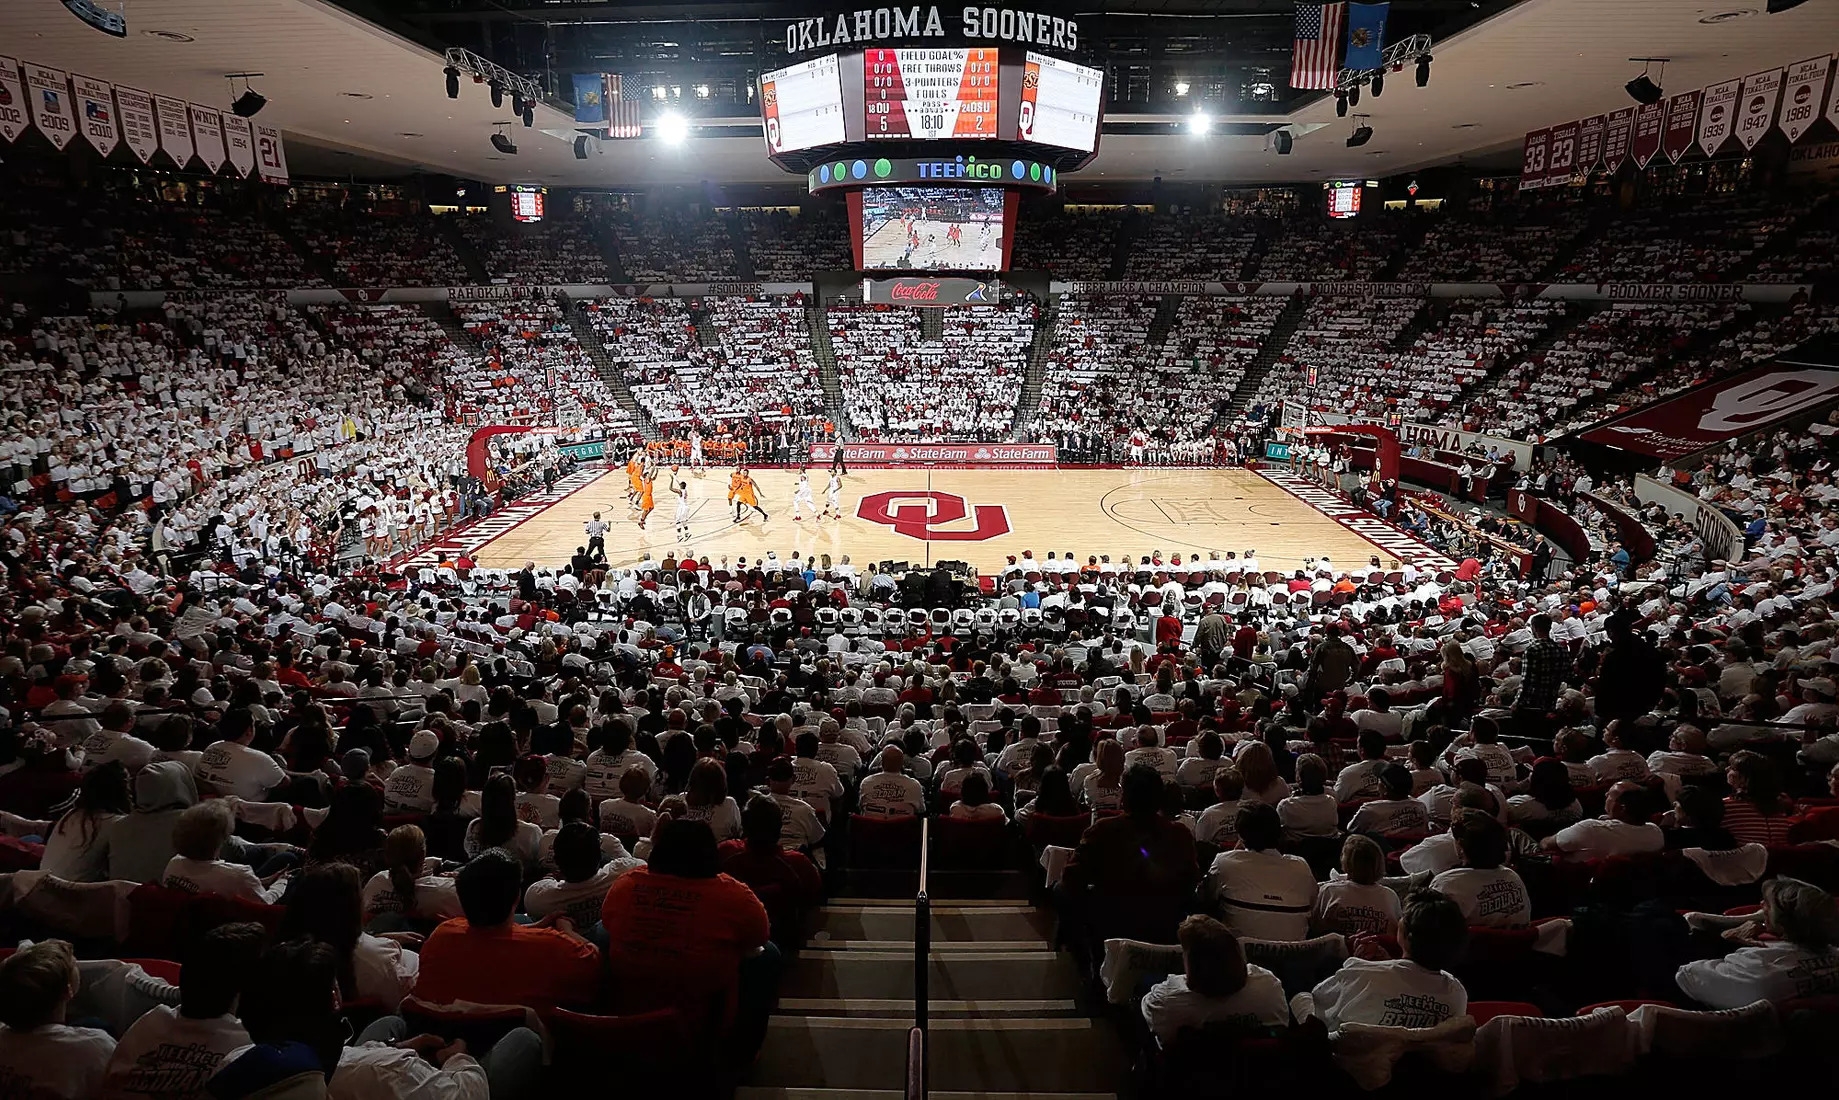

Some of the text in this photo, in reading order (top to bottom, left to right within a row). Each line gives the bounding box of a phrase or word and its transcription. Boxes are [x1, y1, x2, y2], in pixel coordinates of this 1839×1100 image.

[787, 6, 1078, 54] OKLAHOMA SOONERS
[878, 51, 884, 61] 0
[901, 51, 926, 60] FIELD
[977, 51, 984, 60] 0
[902, 64, 962, 73] FREE THROWS
[1801, 63, 1818, 73] NCAA
[905, 78, 959, 87] 3-POINTERS
[1754, 76, 1771, 85] NCAA
[1788, 69, 1826, 84] FINAL FOUR
[881, 90, 887, 100] 0
[916, 90, 947, 99] FOULS
[1714, 86, 1729, 95] NCAA
[1744, 81, 1780, 96] FINAL FOUR
[1705, 91, 1736, 104] FINAL FOUR
[876, 103, 890, 114] OU
[971, 102, 990, 113] OSU
[1785, 105, 1811, 122] 1988
[41, 113, 70, 131] 2009
[192, 109, 218, 127] WNIT
[880, 116, 888, 132] 5
[921, 115, 943, 130] 18:10
[975, 116, 983, 131] 2
[1742, 114, 1767, 131] 1947
[89, 123, 113, 139] 2010
[1553, 127, 1576, 140] TISDALE
[1702, 124, 1725, 139] 1939
[232, 138, 248, 149] 1994
[1528, 134, 1548, 147] ADAMS
[260, 138, 282, 169] 21
[1524, 144, 1545, 173] 33
[1550, 139, 1573, 169] 23
[917, 156, 1002, 179] TEEMCO
[448, 288, 475, 300] RAH
[708, 283, 762, 294] #SOONERS
[891, 282, 941, 301] Coca-Cola
[1072, 282, 1206, 294] CHEER LIKE A CHAMPION
[1609, 284, 1743, 301] BOOMER SOONER
[857, 491, 1011, 541] OU
[1479, 889, 1524, 917] BEDLAM
[1401, 994, 1450, 1017] TEEMCO
